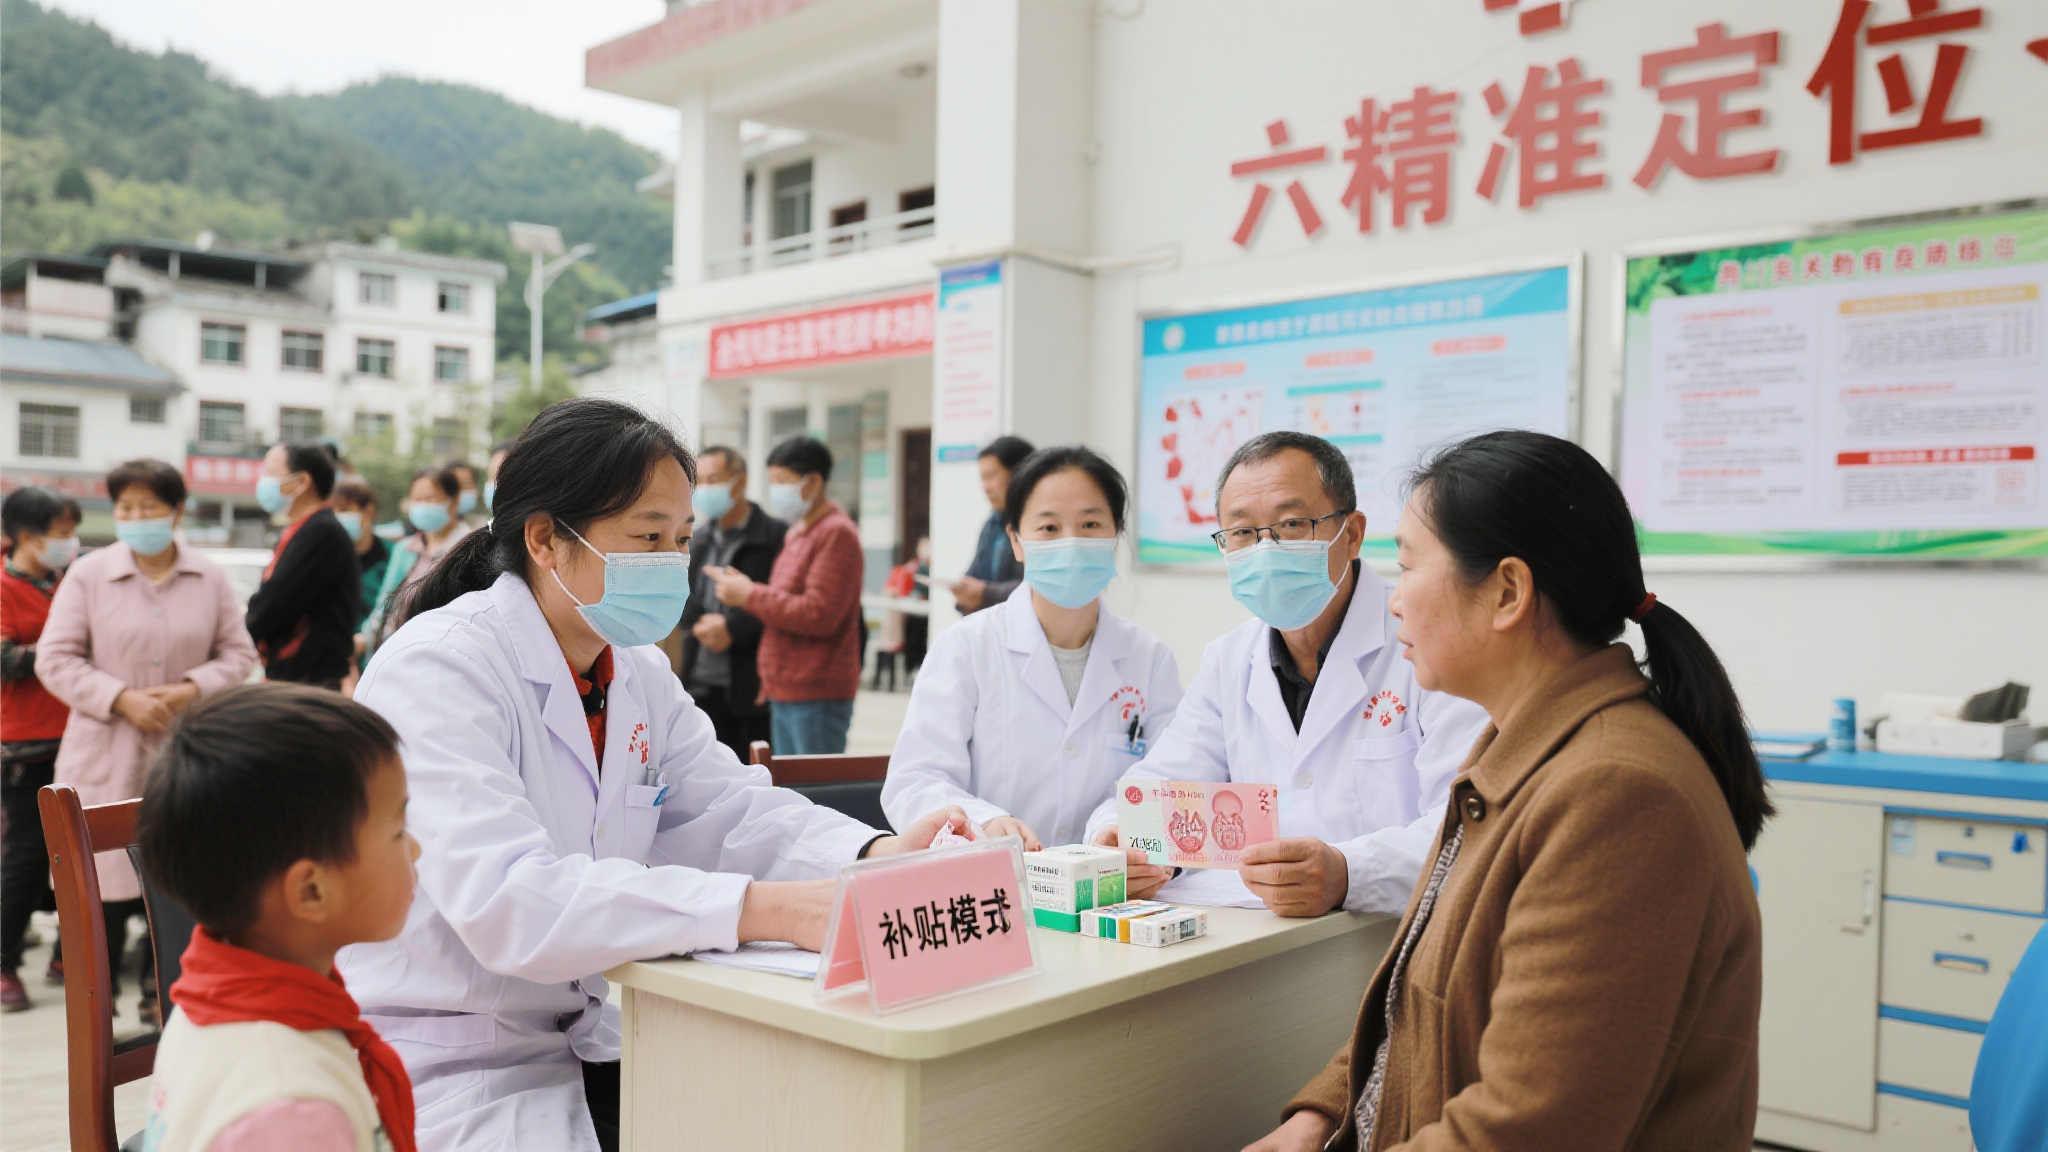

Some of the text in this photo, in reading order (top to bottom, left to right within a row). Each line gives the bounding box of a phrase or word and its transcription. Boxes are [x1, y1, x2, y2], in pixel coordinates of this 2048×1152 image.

[1230, 0, 2048, 247] 六精准定位
[878, 887, 1012, 960] 补贴模式
